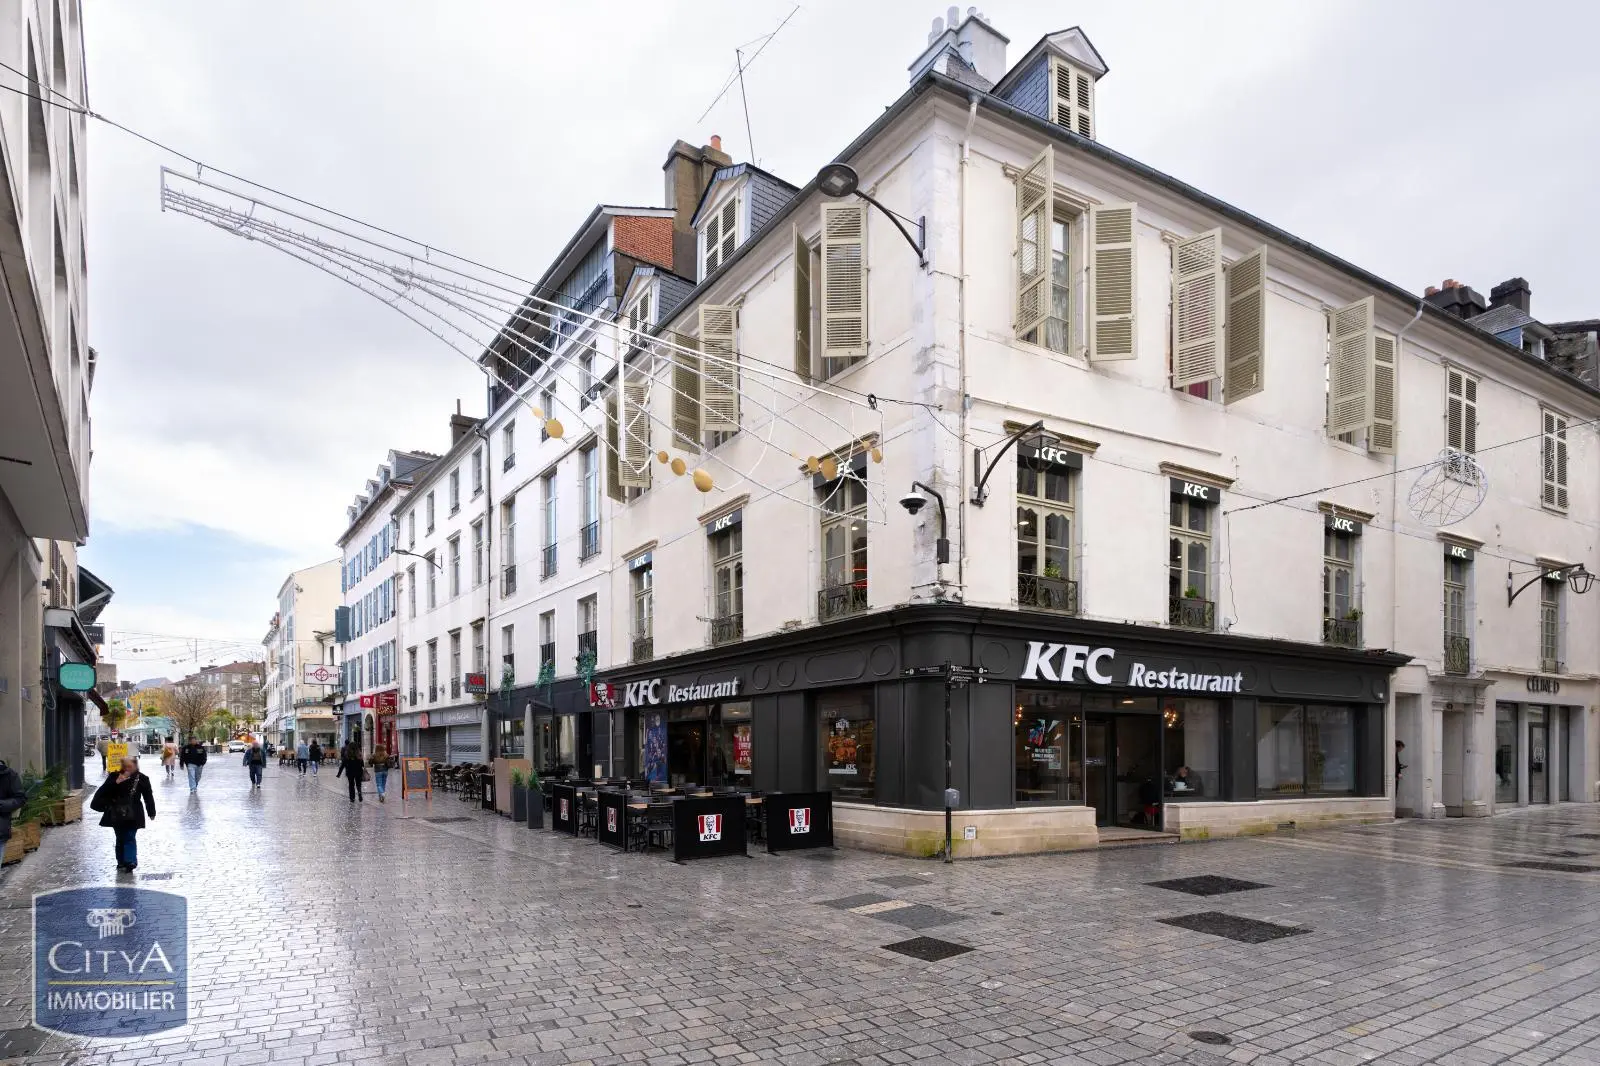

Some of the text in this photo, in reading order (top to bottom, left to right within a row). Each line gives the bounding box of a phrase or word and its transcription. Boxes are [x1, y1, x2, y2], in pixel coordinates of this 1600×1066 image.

[1034, 446, 1067, 464] KFC
[1183, 482, 1208, 499] KFC
[715, 514, 733, 531] KFC
[1335, 517, 1354, 531] KFC
[1452, 545, 1466, 558] KFC
[635, 554, 647, 568] KFC
[1020, 641, 1243, 693] KFC Restaurant
[623, 676, 739, 707] KFC Restaurant
[703, 833, 718, 841] KFC
